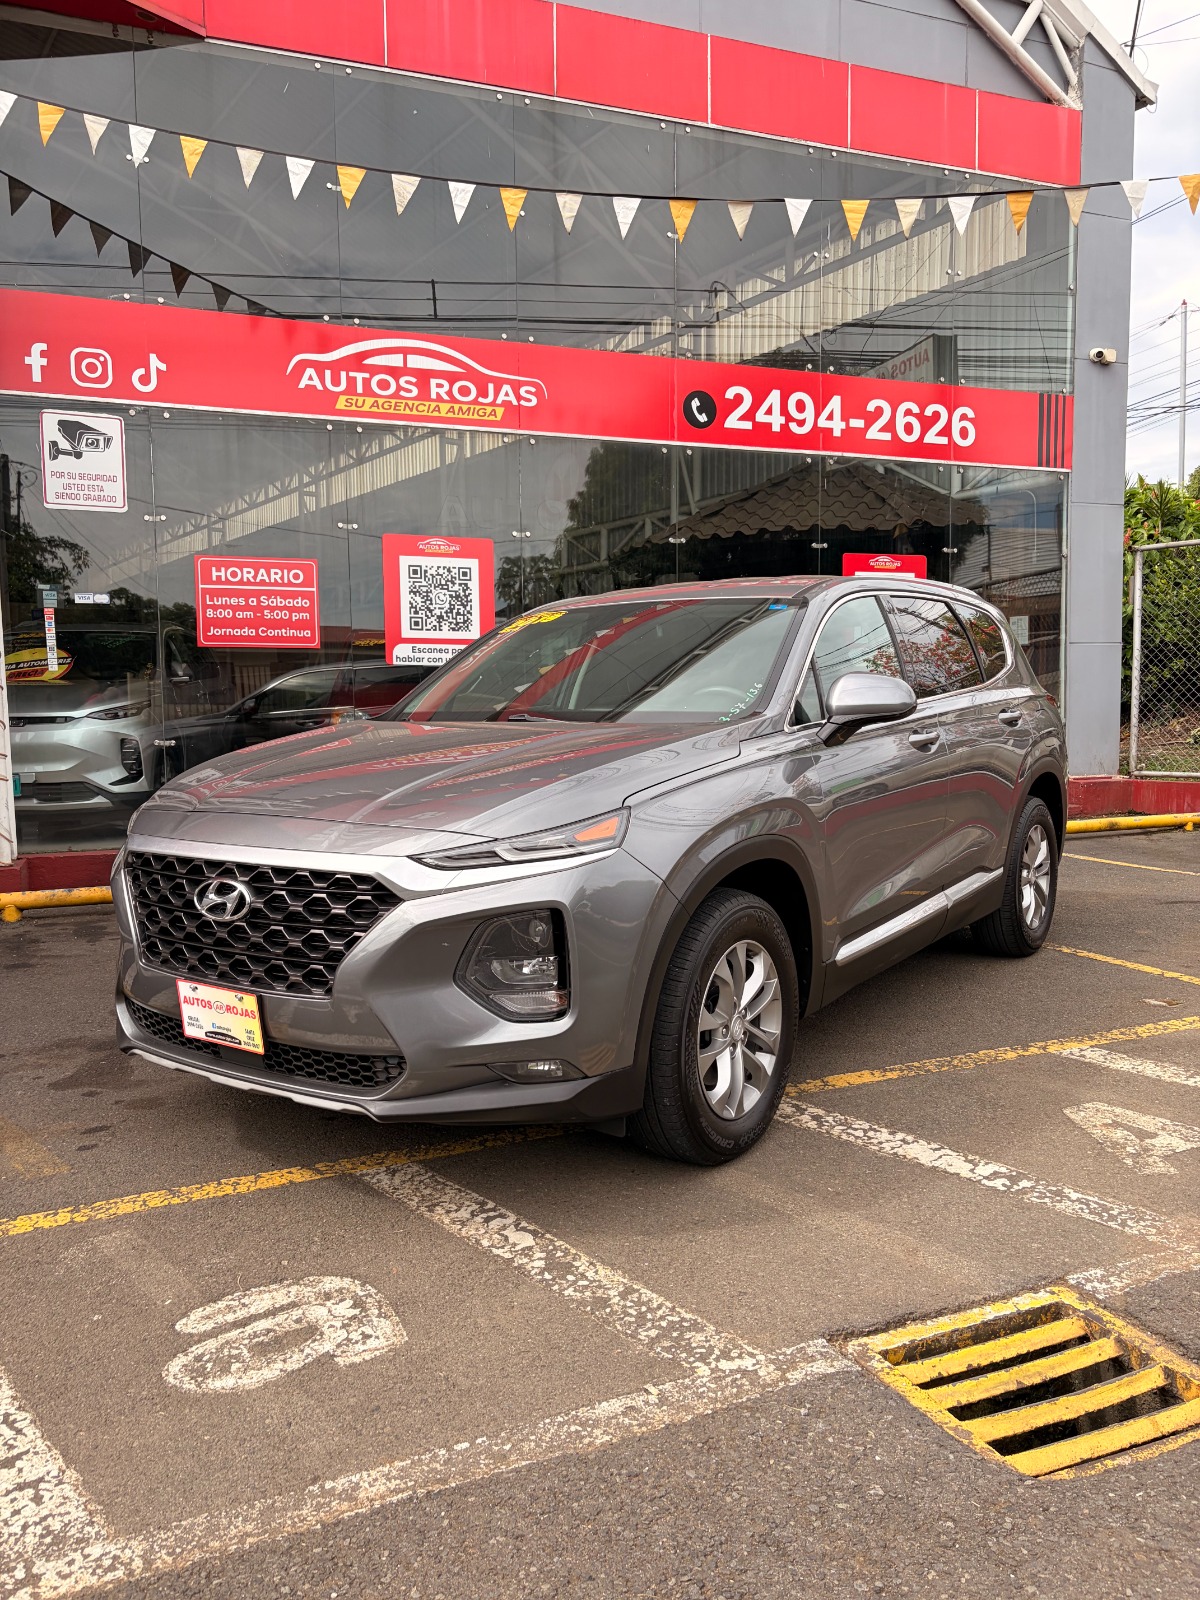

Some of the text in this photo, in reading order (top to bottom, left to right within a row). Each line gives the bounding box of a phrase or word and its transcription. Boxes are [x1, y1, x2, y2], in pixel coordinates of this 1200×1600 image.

[297, 367, 538, 407] AUTOS ROJAS
[343, 397, 498, 419] SU AGENCIA AMIGA
[723, 385, 977, 448] 2494-2626
[50, 471, 118, 483] POR SU SEGURIDAD
[62, 483, 105, 493] USTED ESTA
[54, 492, 117, 503] SIENDO GRABADO
[211, 566, 304, 584] HORARIO
[206, 594, 310, 607] Lunes a Sábado
[206, 608, 233, 618] 8:00
[235, 610, 254, 619] am
[263, 610, 289, 620] 5:00
[292, 612, 310, 621] pm
[207, 626, 311, 637] Jornada Continua
[411, 645, 449, 654] Escanea
[17, 658, 72, 669] AUTOMRIZ
[395, 655, 425, 663] hablar
[182, 995, 257, 1020] AUTOS AR ROJAS
